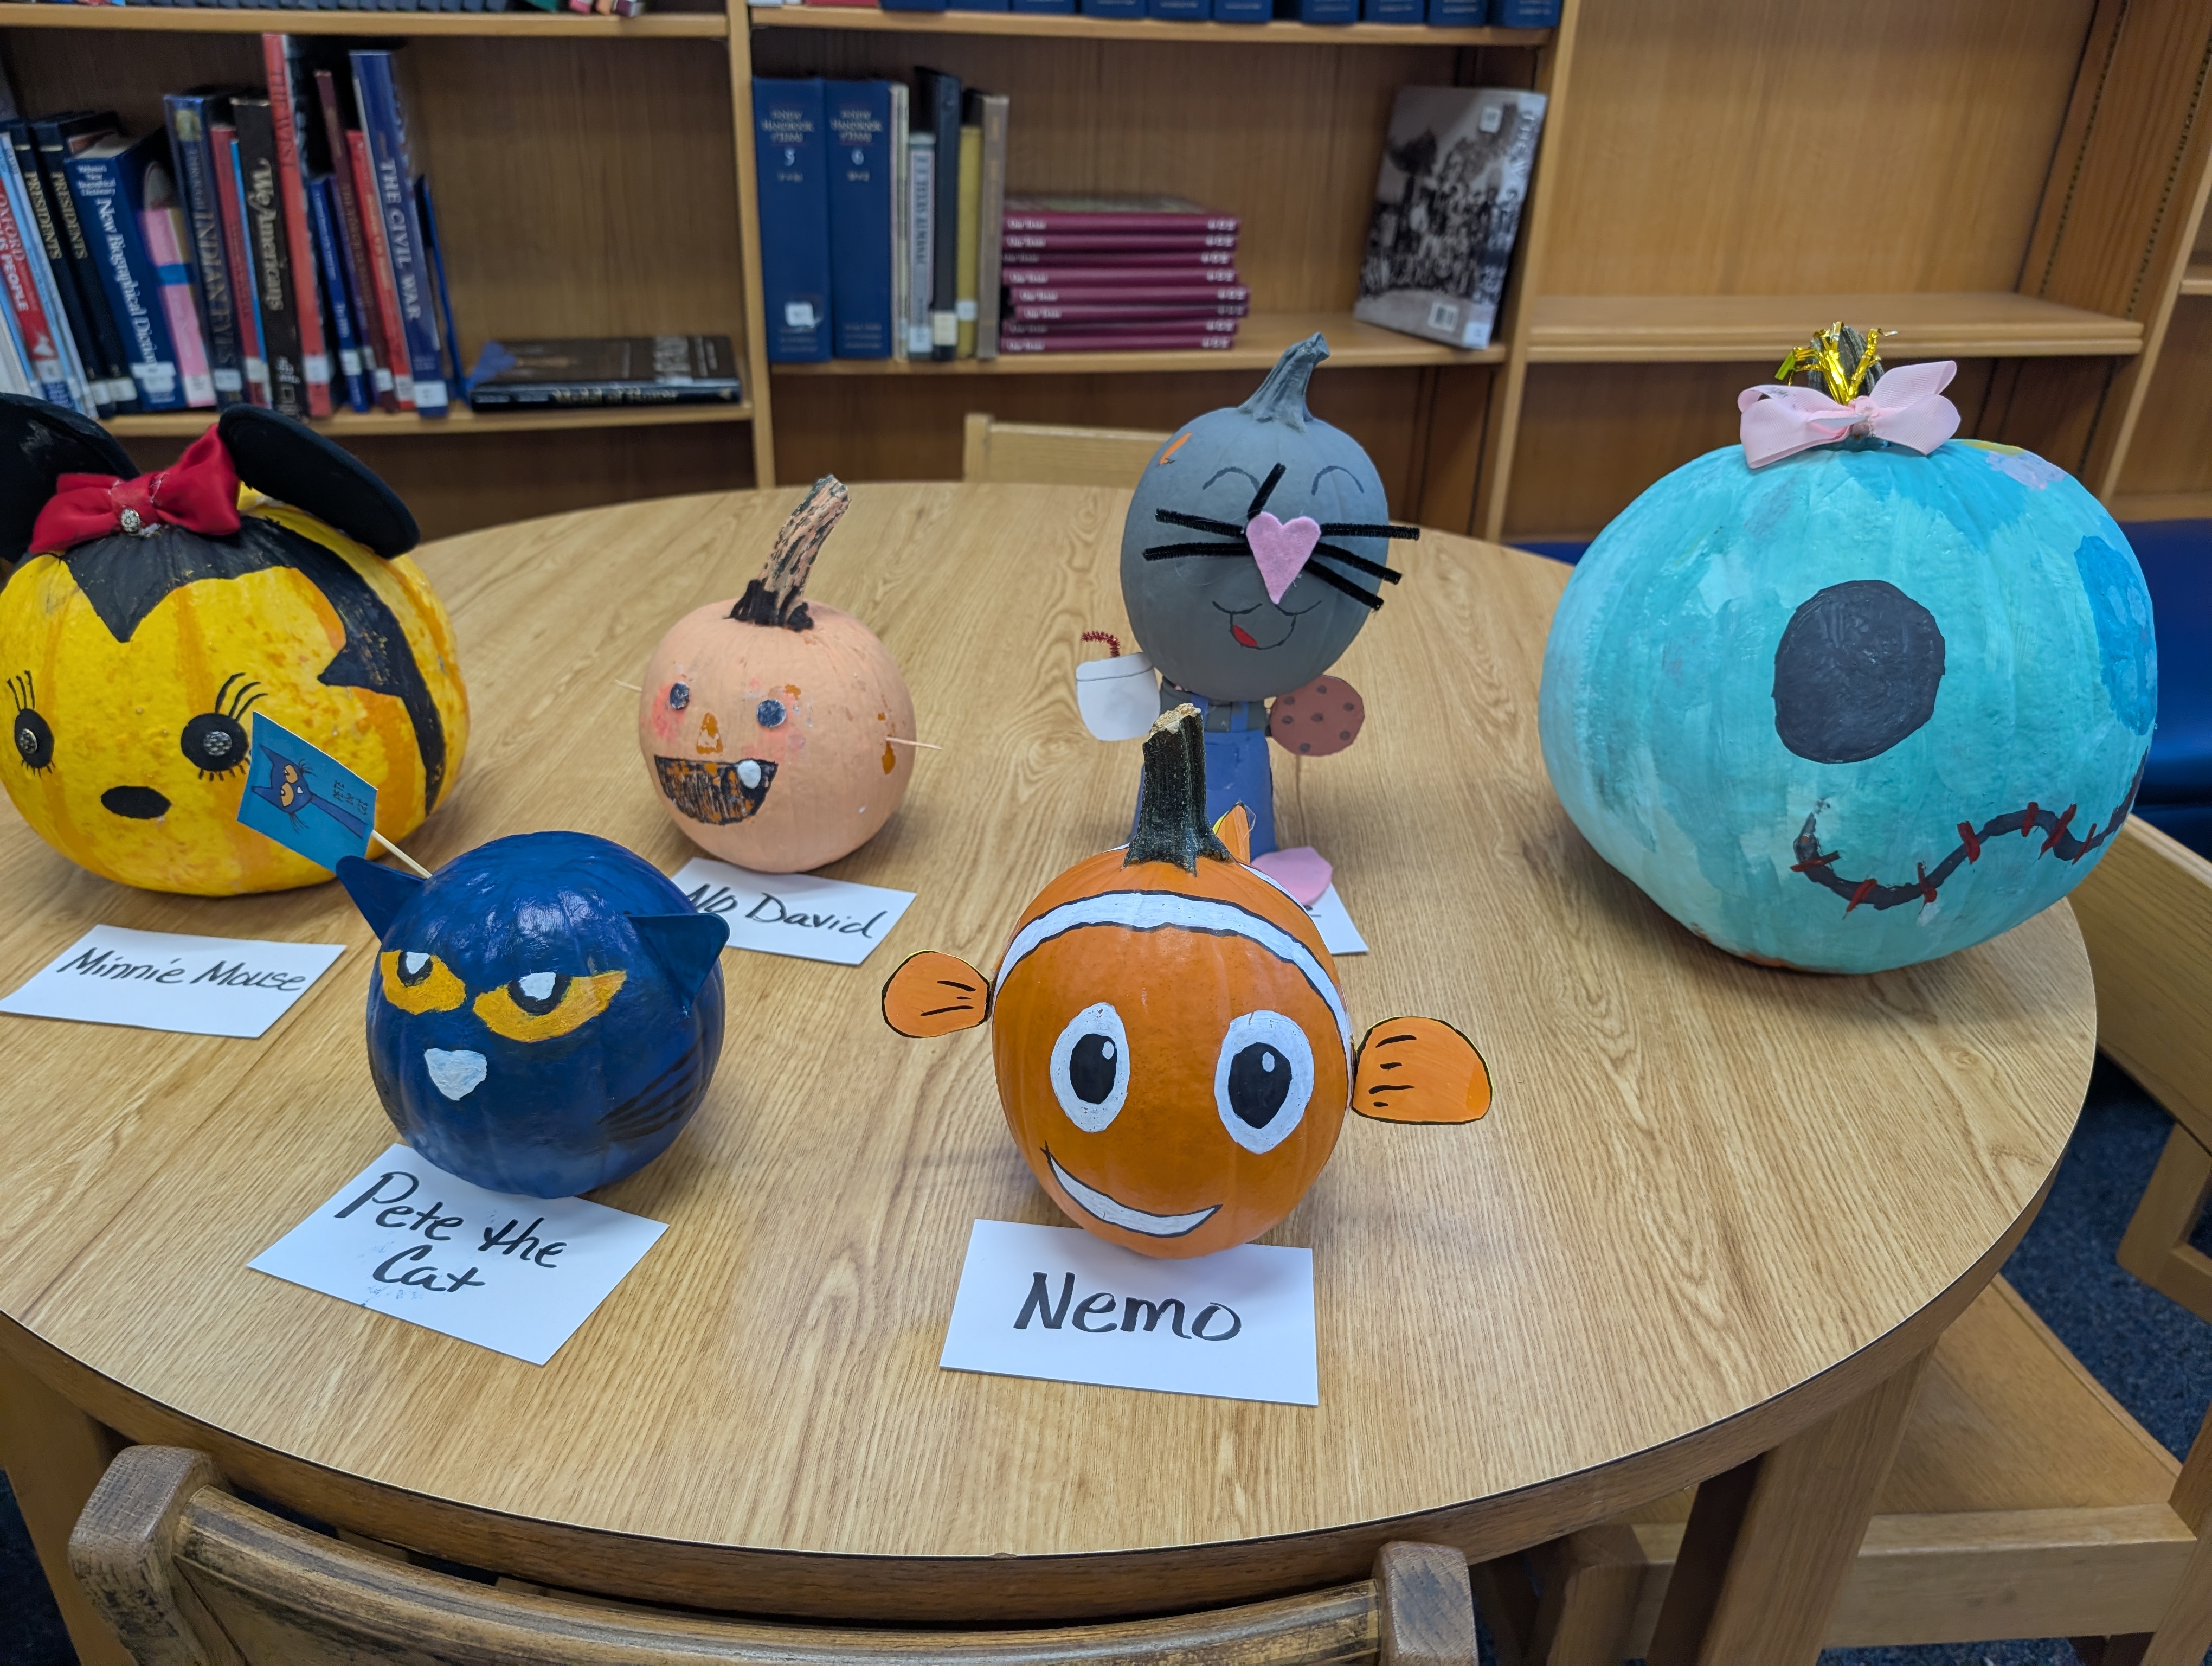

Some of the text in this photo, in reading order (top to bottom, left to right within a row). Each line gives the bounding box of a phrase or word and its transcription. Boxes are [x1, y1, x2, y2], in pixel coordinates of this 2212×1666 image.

[784, 148, 795, 166] 5
[851, 148, 864, 165] 6
[25, 171, 62, 260] PRESIDENTS
[50, 171, 88, 259] PRESIDENTS
[381, 159, 421, 322] THE CIVIL WAR
[2, 253, 29, 312] PEOPLE
[95, 197, 117, 233] New
[107, 233, 147, 316] Biographical
[193, 210, 228, 303] INDIAN
[248, 191, 283, 310] Americans
[333, 780, 345, 802] PETE
[687, 883, 888, 939] No David
[56, 947, 306, 991] Minnie Mouse
[333, 1171, 568, 1268] Pete the
[372, 1244, 487, 1294] Cat
[1013, 1271, 1242, 1341] Nemo
